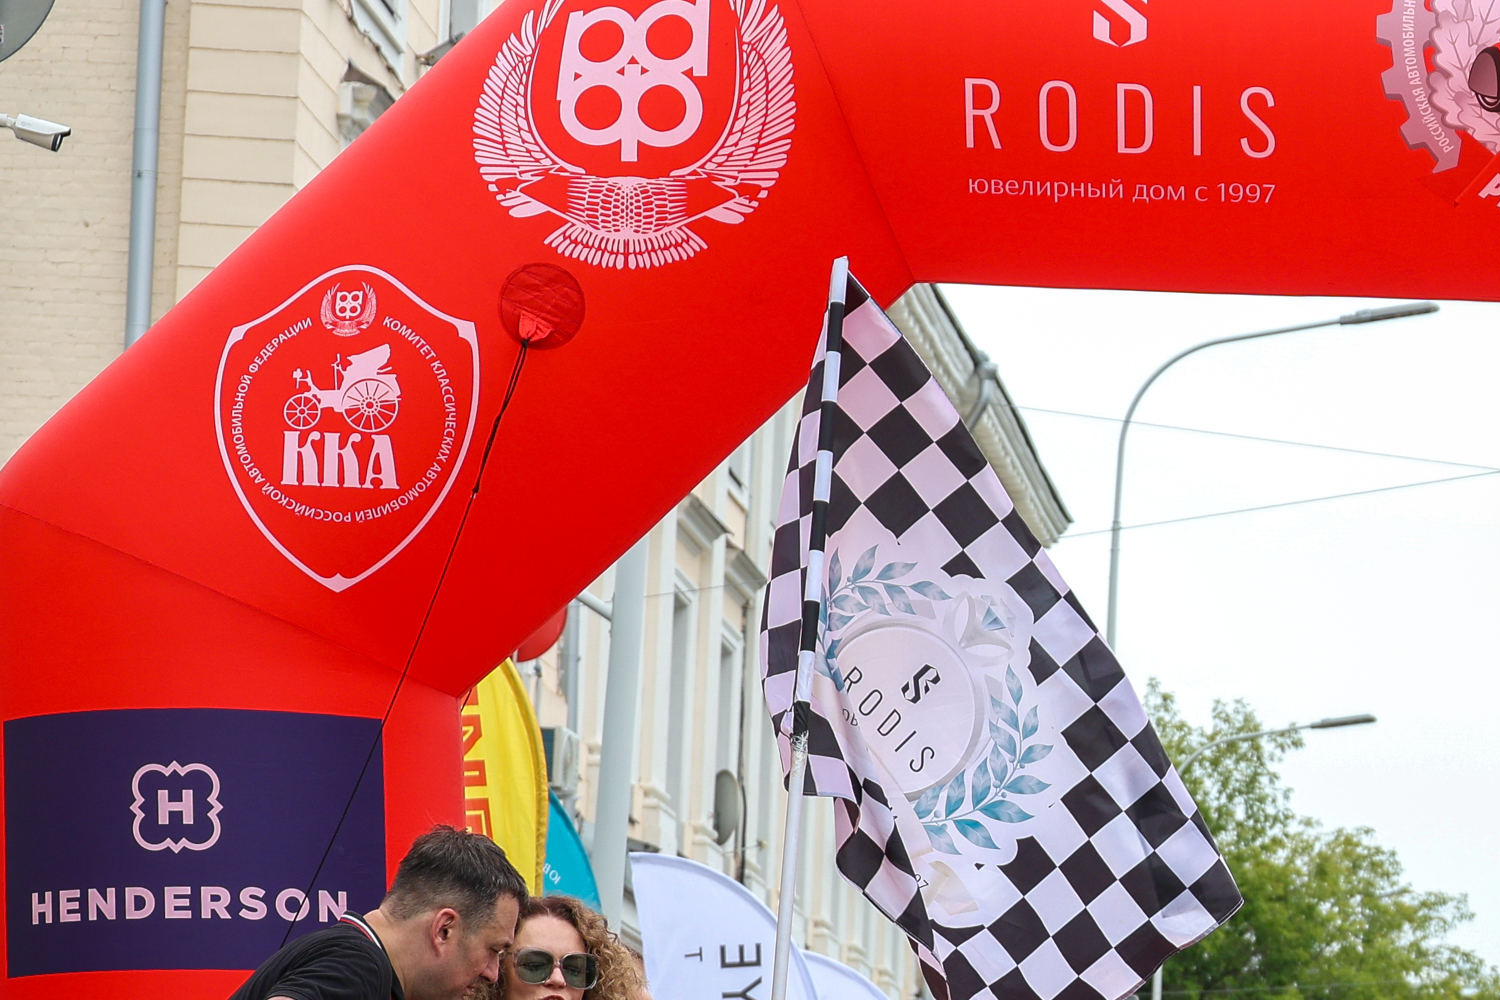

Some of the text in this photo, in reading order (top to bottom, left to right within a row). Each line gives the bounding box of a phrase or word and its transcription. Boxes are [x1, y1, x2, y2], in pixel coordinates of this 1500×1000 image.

[964, 77, 1276, 158] RODIS
[1412, 87, 1454, 154] РОССИЙСКАЯ
[969, 178, 1276, 203] ювелирный дом с 1997
[231, 316, 457, 523] КОМИТЕТ КЛАССИЧЕСКИХ АВТОМОБИЛЕЙ РОССИЙСКОЙ АВТОМОБИЛЬНОЙ ФЕДЕРАЦИИ
[281, 430, 400, 489] ККА
[843, 666, 935, 773] RODIS
[31, 886, 348, 925] HENDERSON
